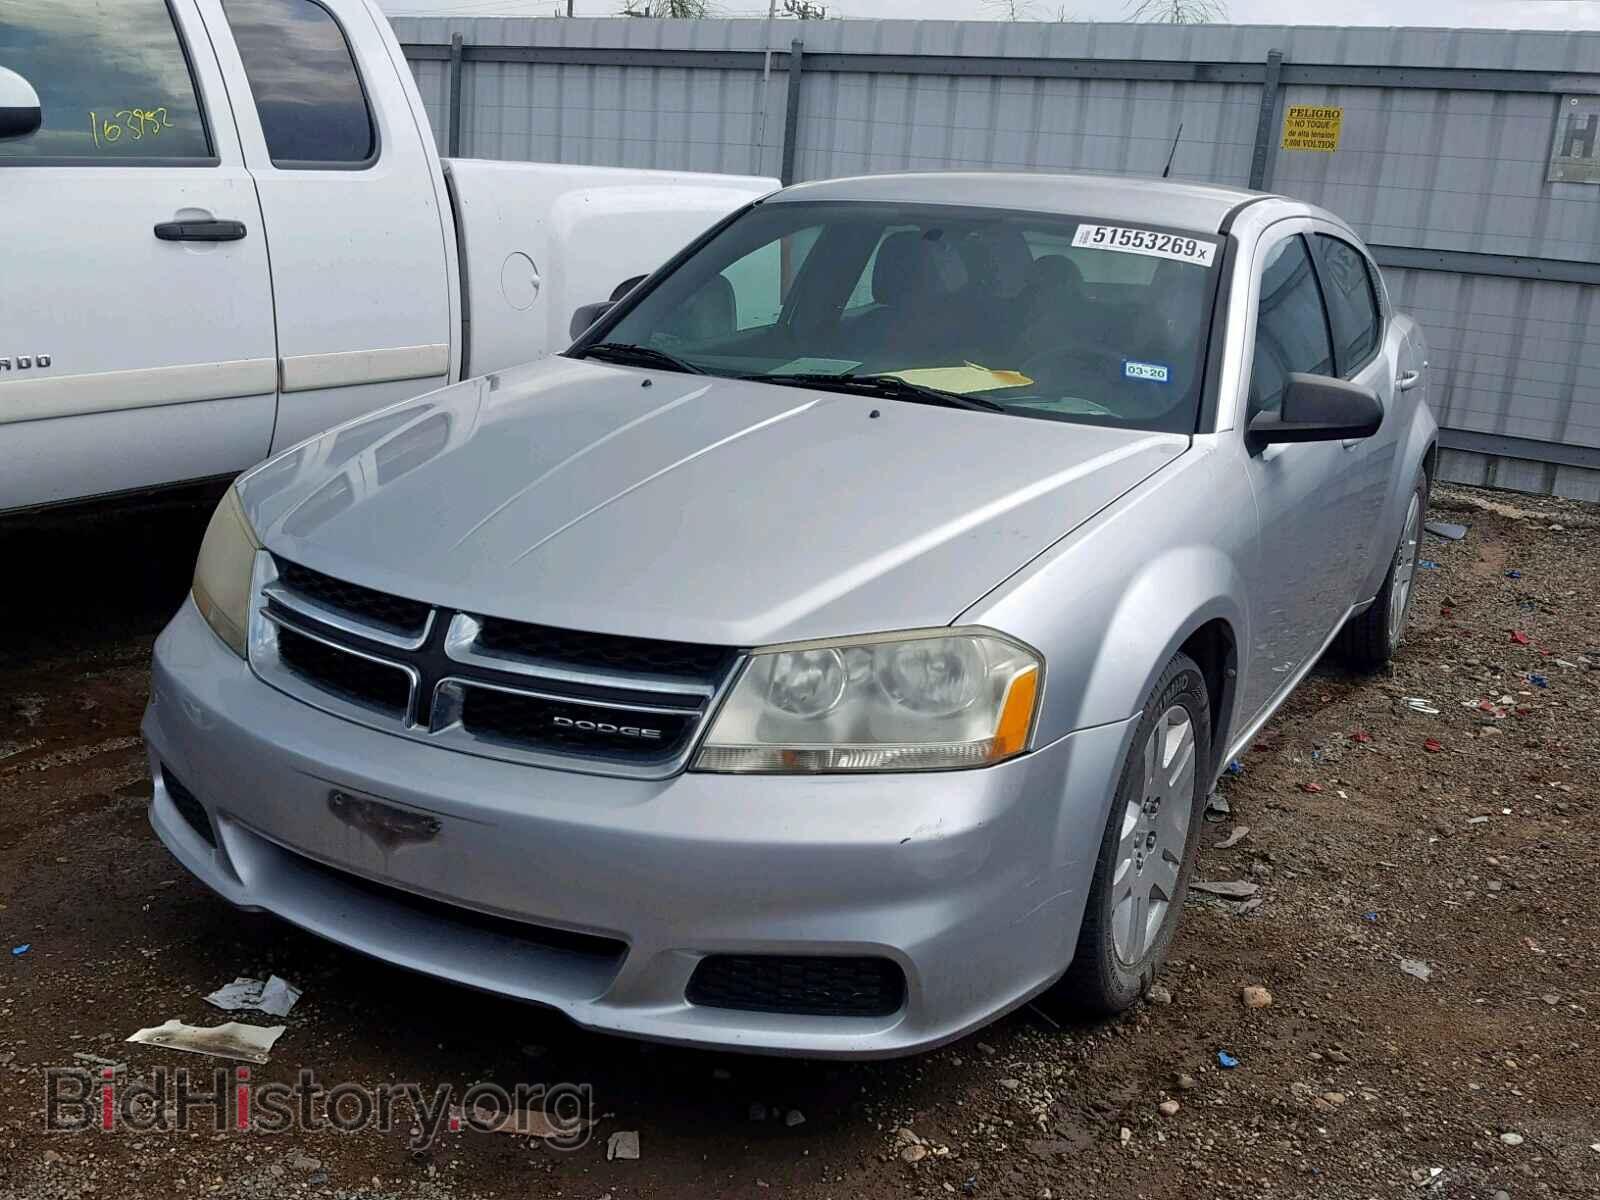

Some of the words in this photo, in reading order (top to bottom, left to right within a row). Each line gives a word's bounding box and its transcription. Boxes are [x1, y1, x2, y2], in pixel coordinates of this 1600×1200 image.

[1289, 108, 1340, 119] PELIGRO
[1294, 120, 1305, 129] NO
[1307, 120, 1331, 129] TOQUE
[1298, 130, 1310, 138] alta
[1302, 139, 1336, 149] VOLTIOS
[1128, 365, 1165, 378] 03-20
[553, 716, 662, 739] DODGE
